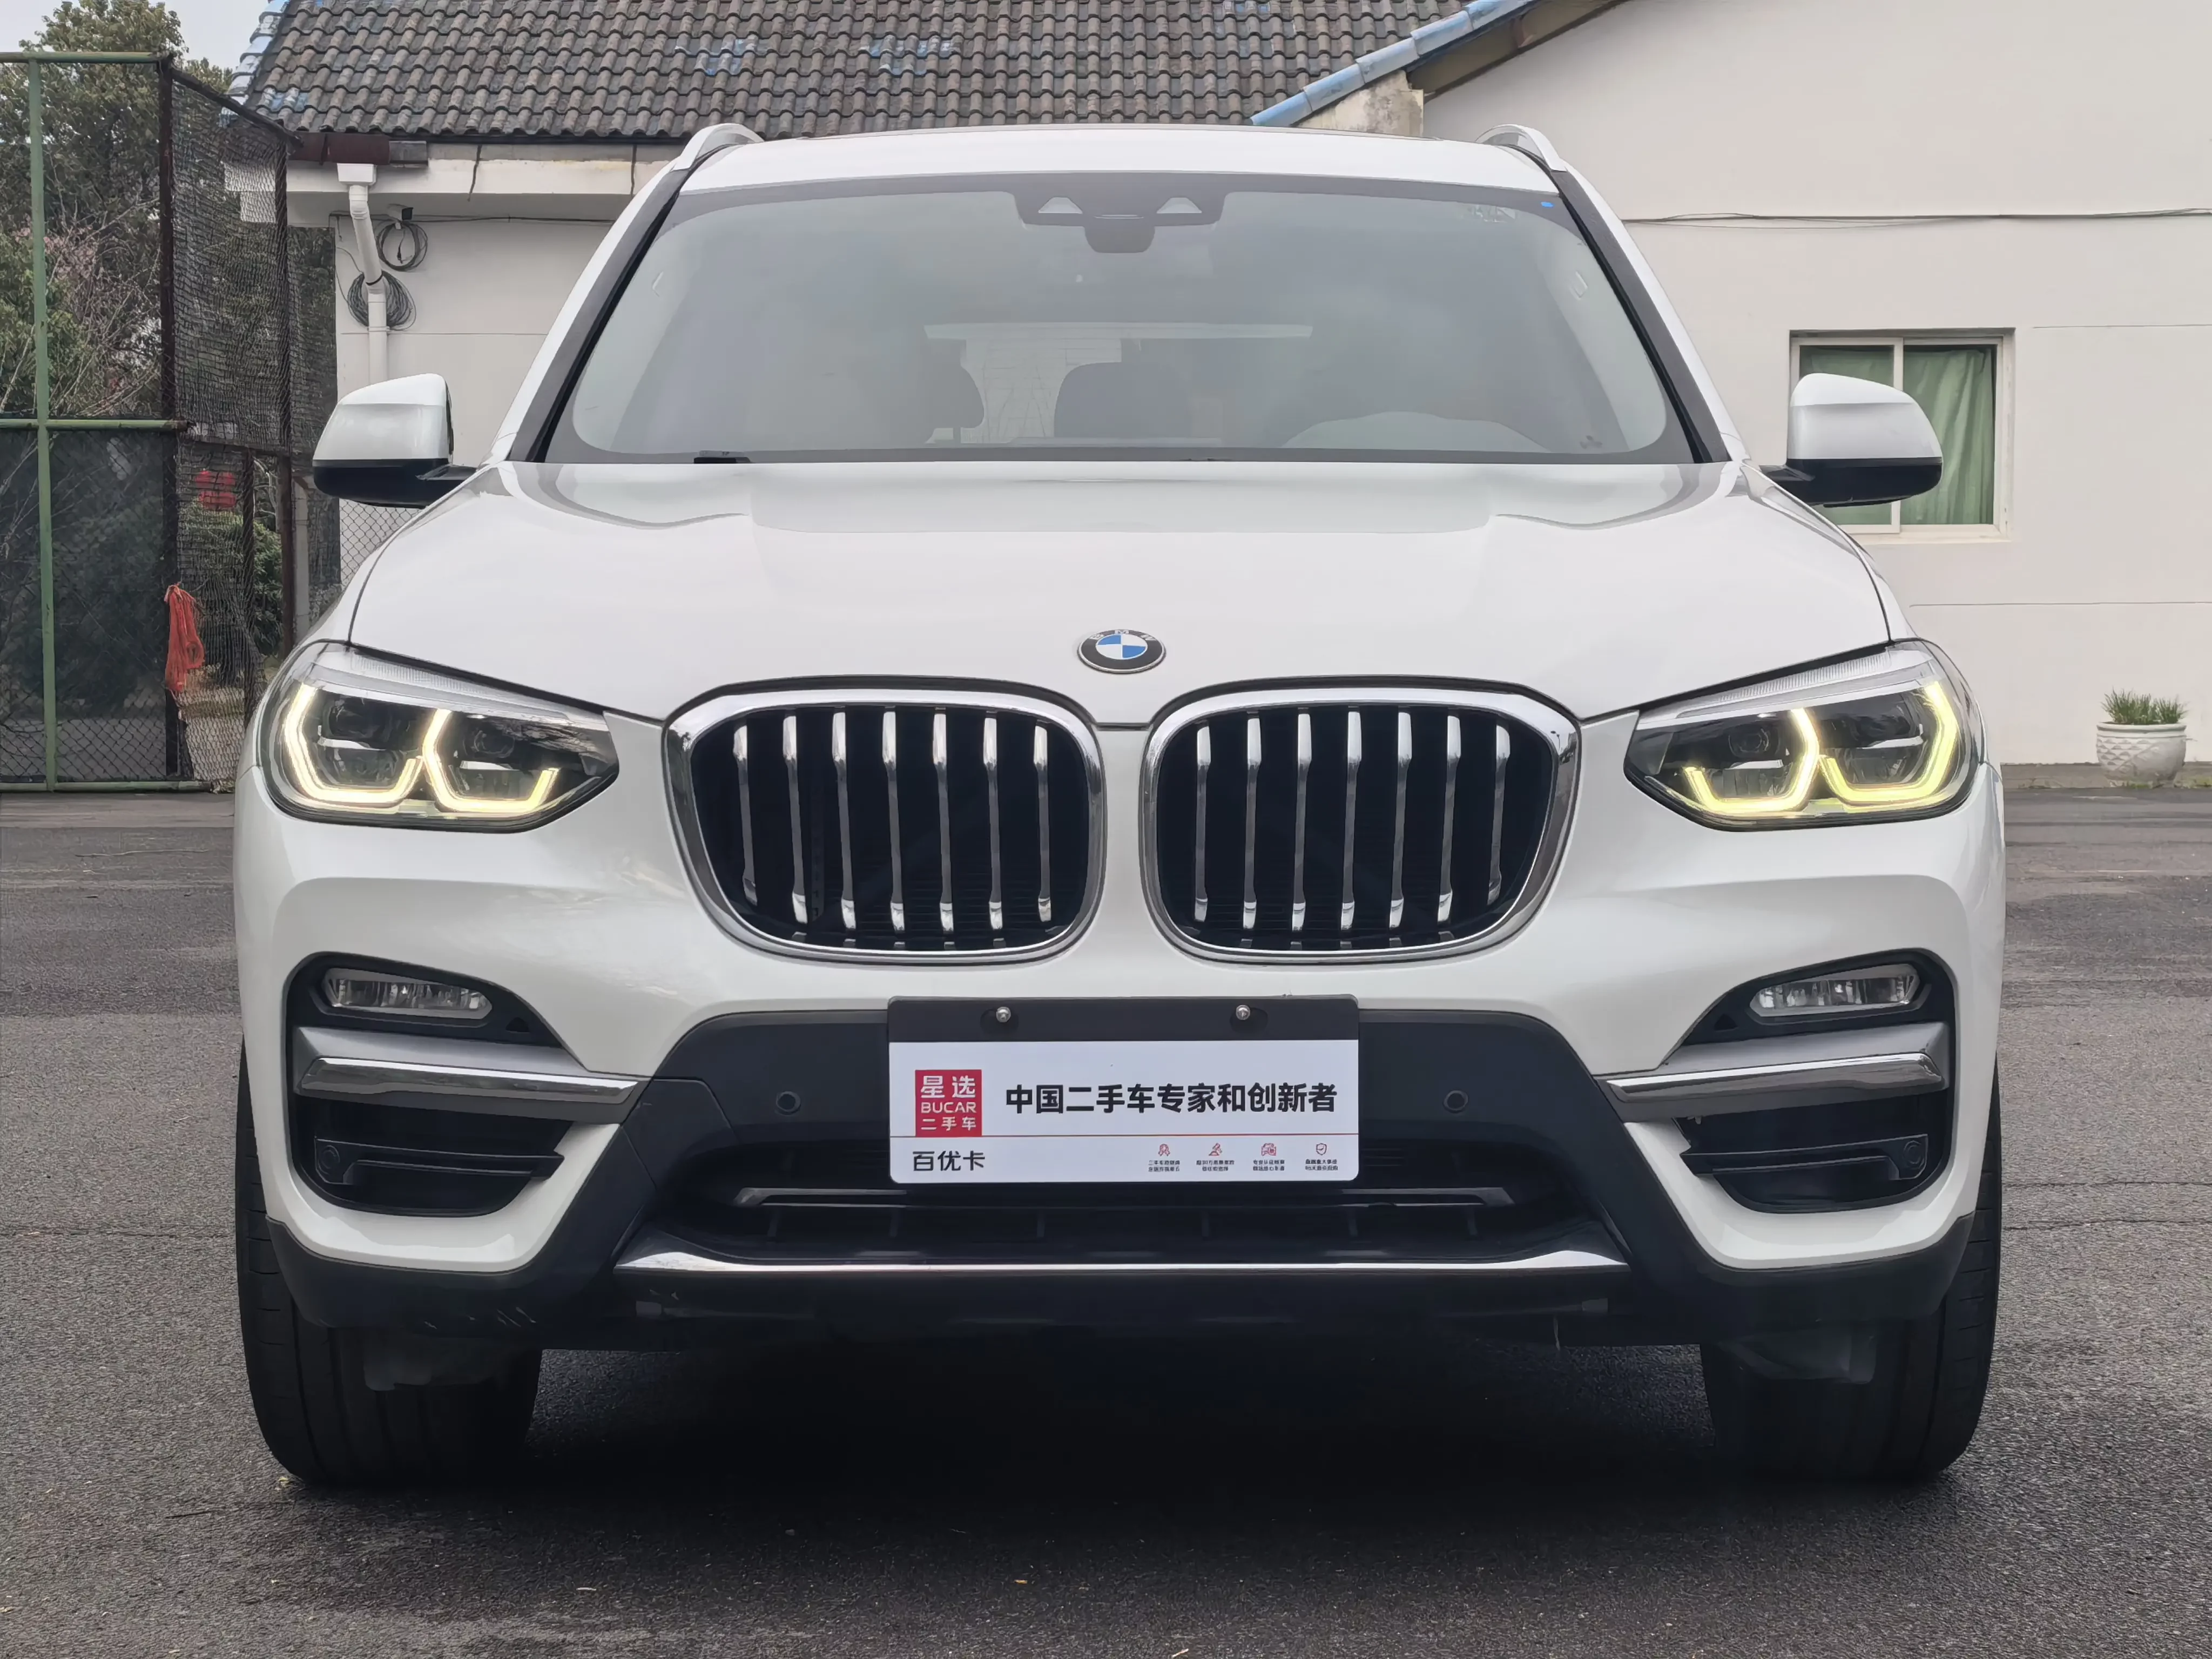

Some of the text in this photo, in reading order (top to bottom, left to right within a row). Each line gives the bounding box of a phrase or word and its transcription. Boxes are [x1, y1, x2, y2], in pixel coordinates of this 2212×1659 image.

[921, 1075, 976, 1098] 星选
[921, 1102, 976, 1114] BUCAR
[1006, 1082, 1338, 1114] 中国二手车专家和创新者
[921, 1116, 976, 1131] 二手车
[913, 1150, 985, 1171] 百优卡
